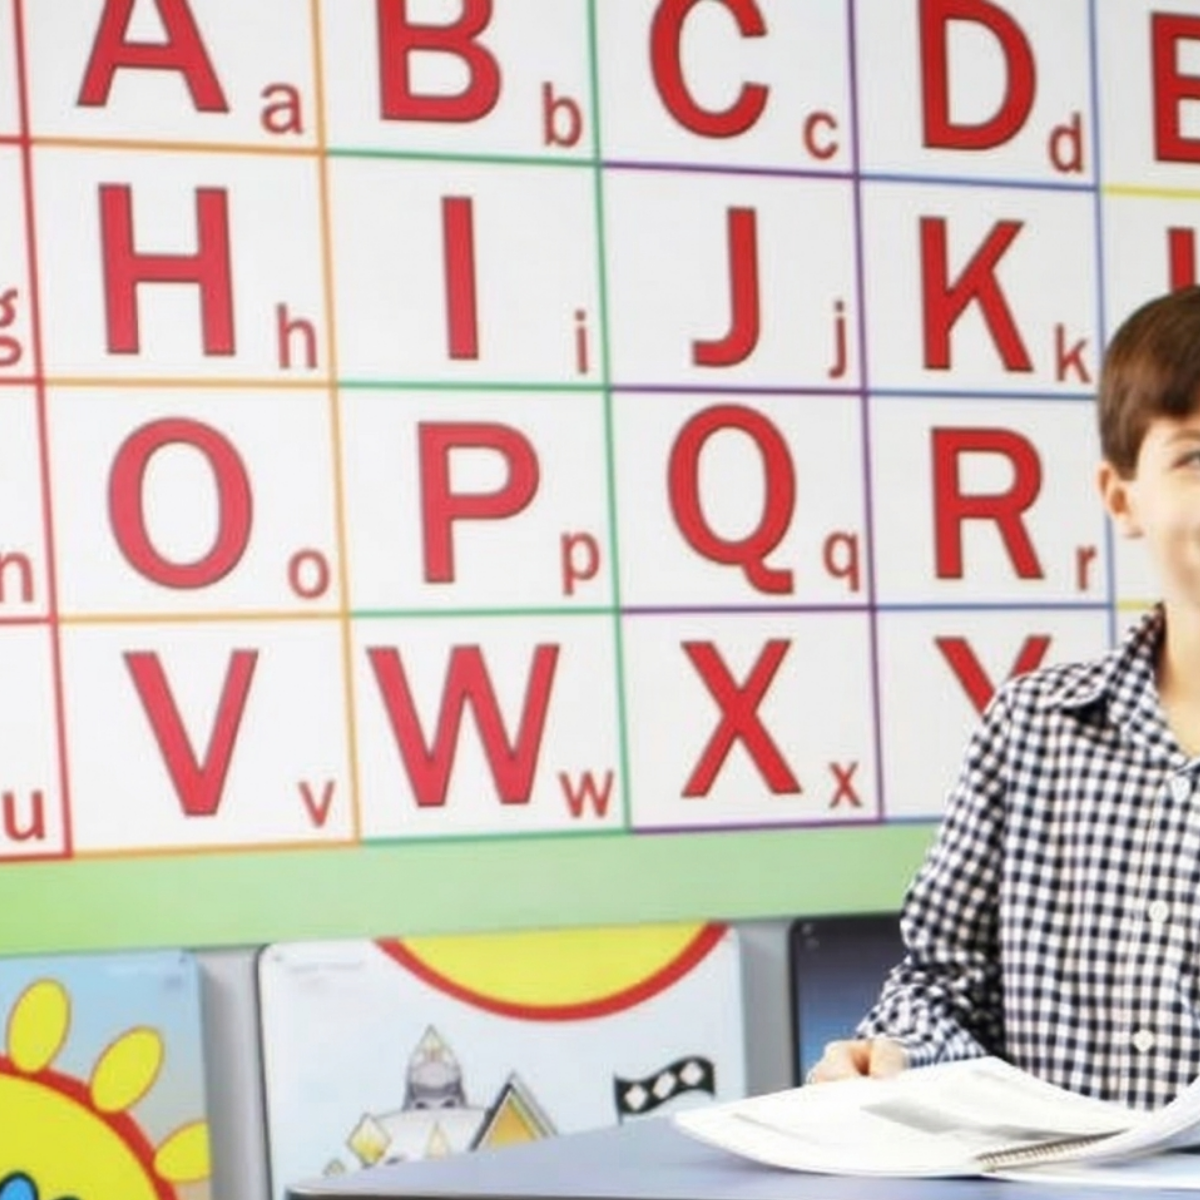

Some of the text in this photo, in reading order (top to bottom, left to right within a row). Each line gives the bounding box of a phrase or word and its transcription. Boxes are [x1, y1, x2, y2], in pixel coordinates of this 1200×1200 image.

[78, 0, 229, 113] A
[262, 84, 303, 134] a
[375, 0, 503, 123] B
[543, 82, 582, 147] b
[648, 0, 770, 138] C
[804, 112, 838, 160] c
[918, 0, 1038, 151] D
[1048, 113, 1083, 173] d
[99, 183, 236, 357] H
[278, 305, 317, 368] h
[441, 196, 479, 360] I
[576, 311, 587, 373] i
[692, 206, 762, 368] J
[829, 301, 846, 379] j
[919, 216, 1034, 373] K
[1056, 324, 1090, 383] k
[0, 554, 33, 601] n
[108, 417, 254, 590] O
[289, 551, 329, 598] o
[418, 421, 542, 584] P
[562, 533, 599, 595] p
[667, 403, 798, 595] Q
[824, 532, 859, 592] q
[930, 426, 1045, 580] R
[1077, 547, 1096, 590] r
[3, 792, 44, 841] u
[122, 649, 260, 817] V
[301, 783, 333, 826] v
[364, 643, 562, 810] W
[560, 772, 613, 817] w
[680, 638, 802, 798] X
[831, 763, 861, 807] x
